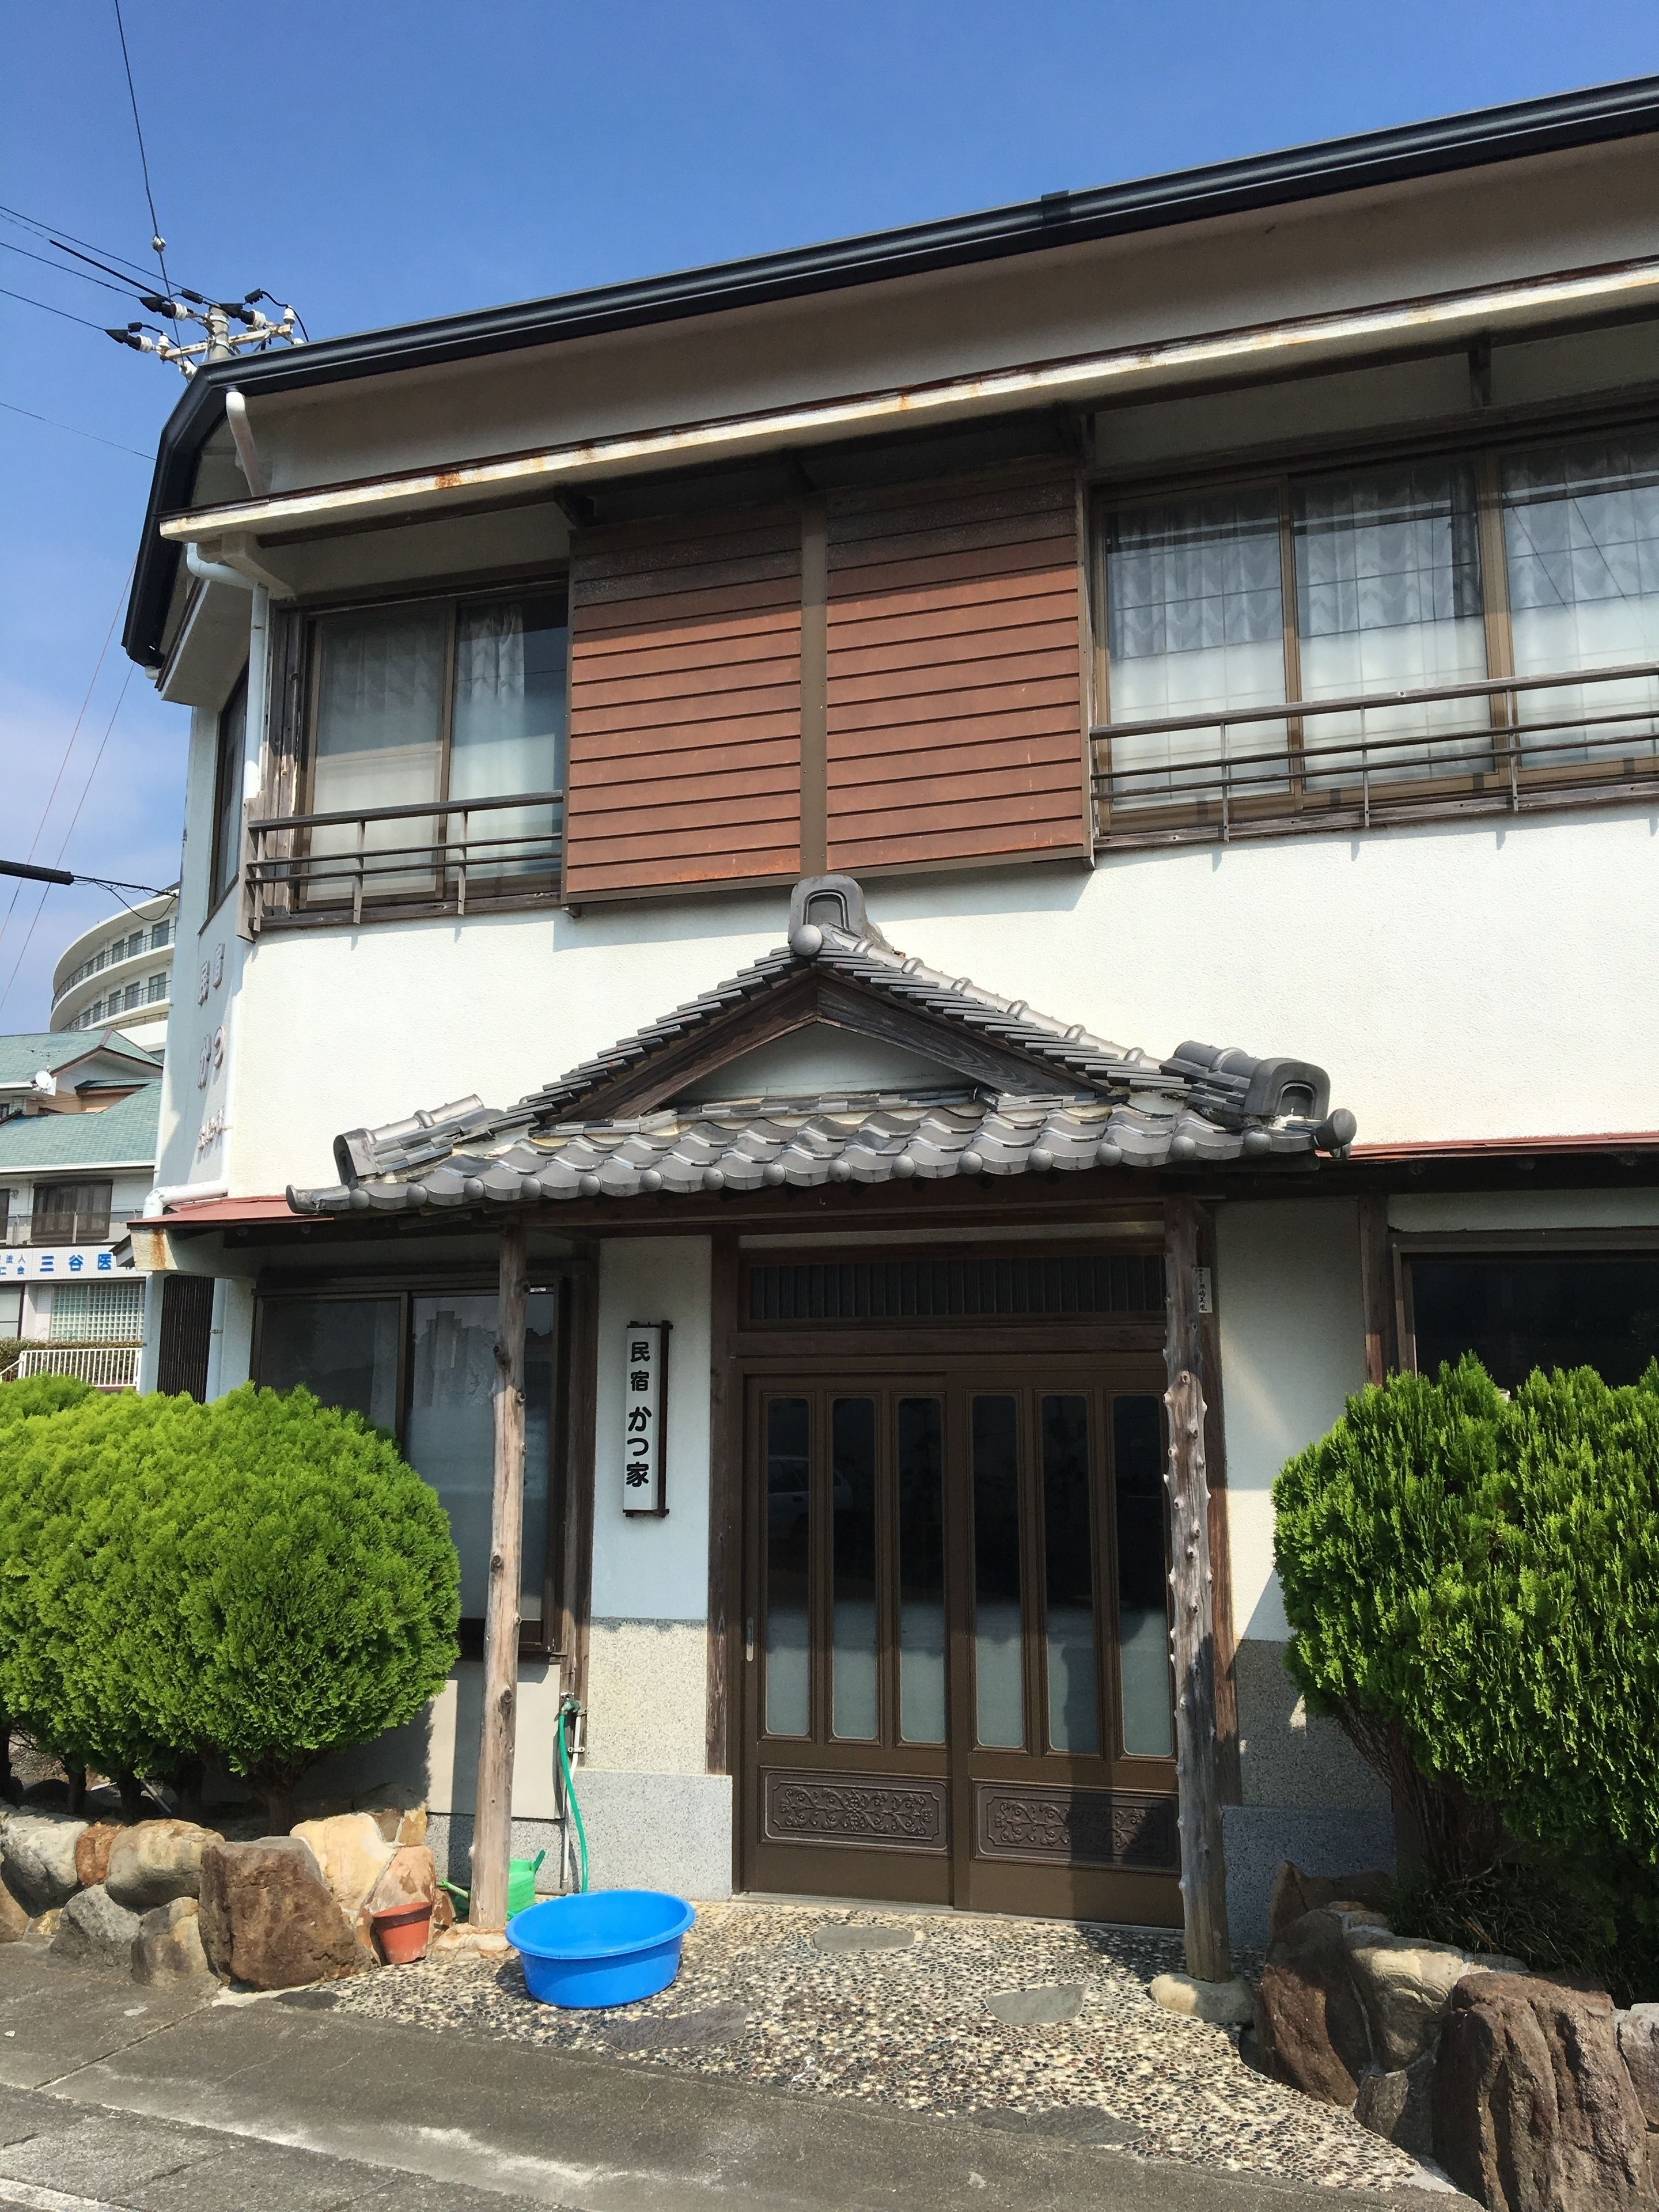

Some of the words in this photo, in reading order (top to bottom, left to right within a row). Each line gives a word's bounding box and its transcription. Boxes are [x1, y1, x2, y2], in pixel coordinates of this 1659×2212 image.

[0, 1254, 25, 1263] 法人
[40, 1253, 133, 1272] 三谷医
